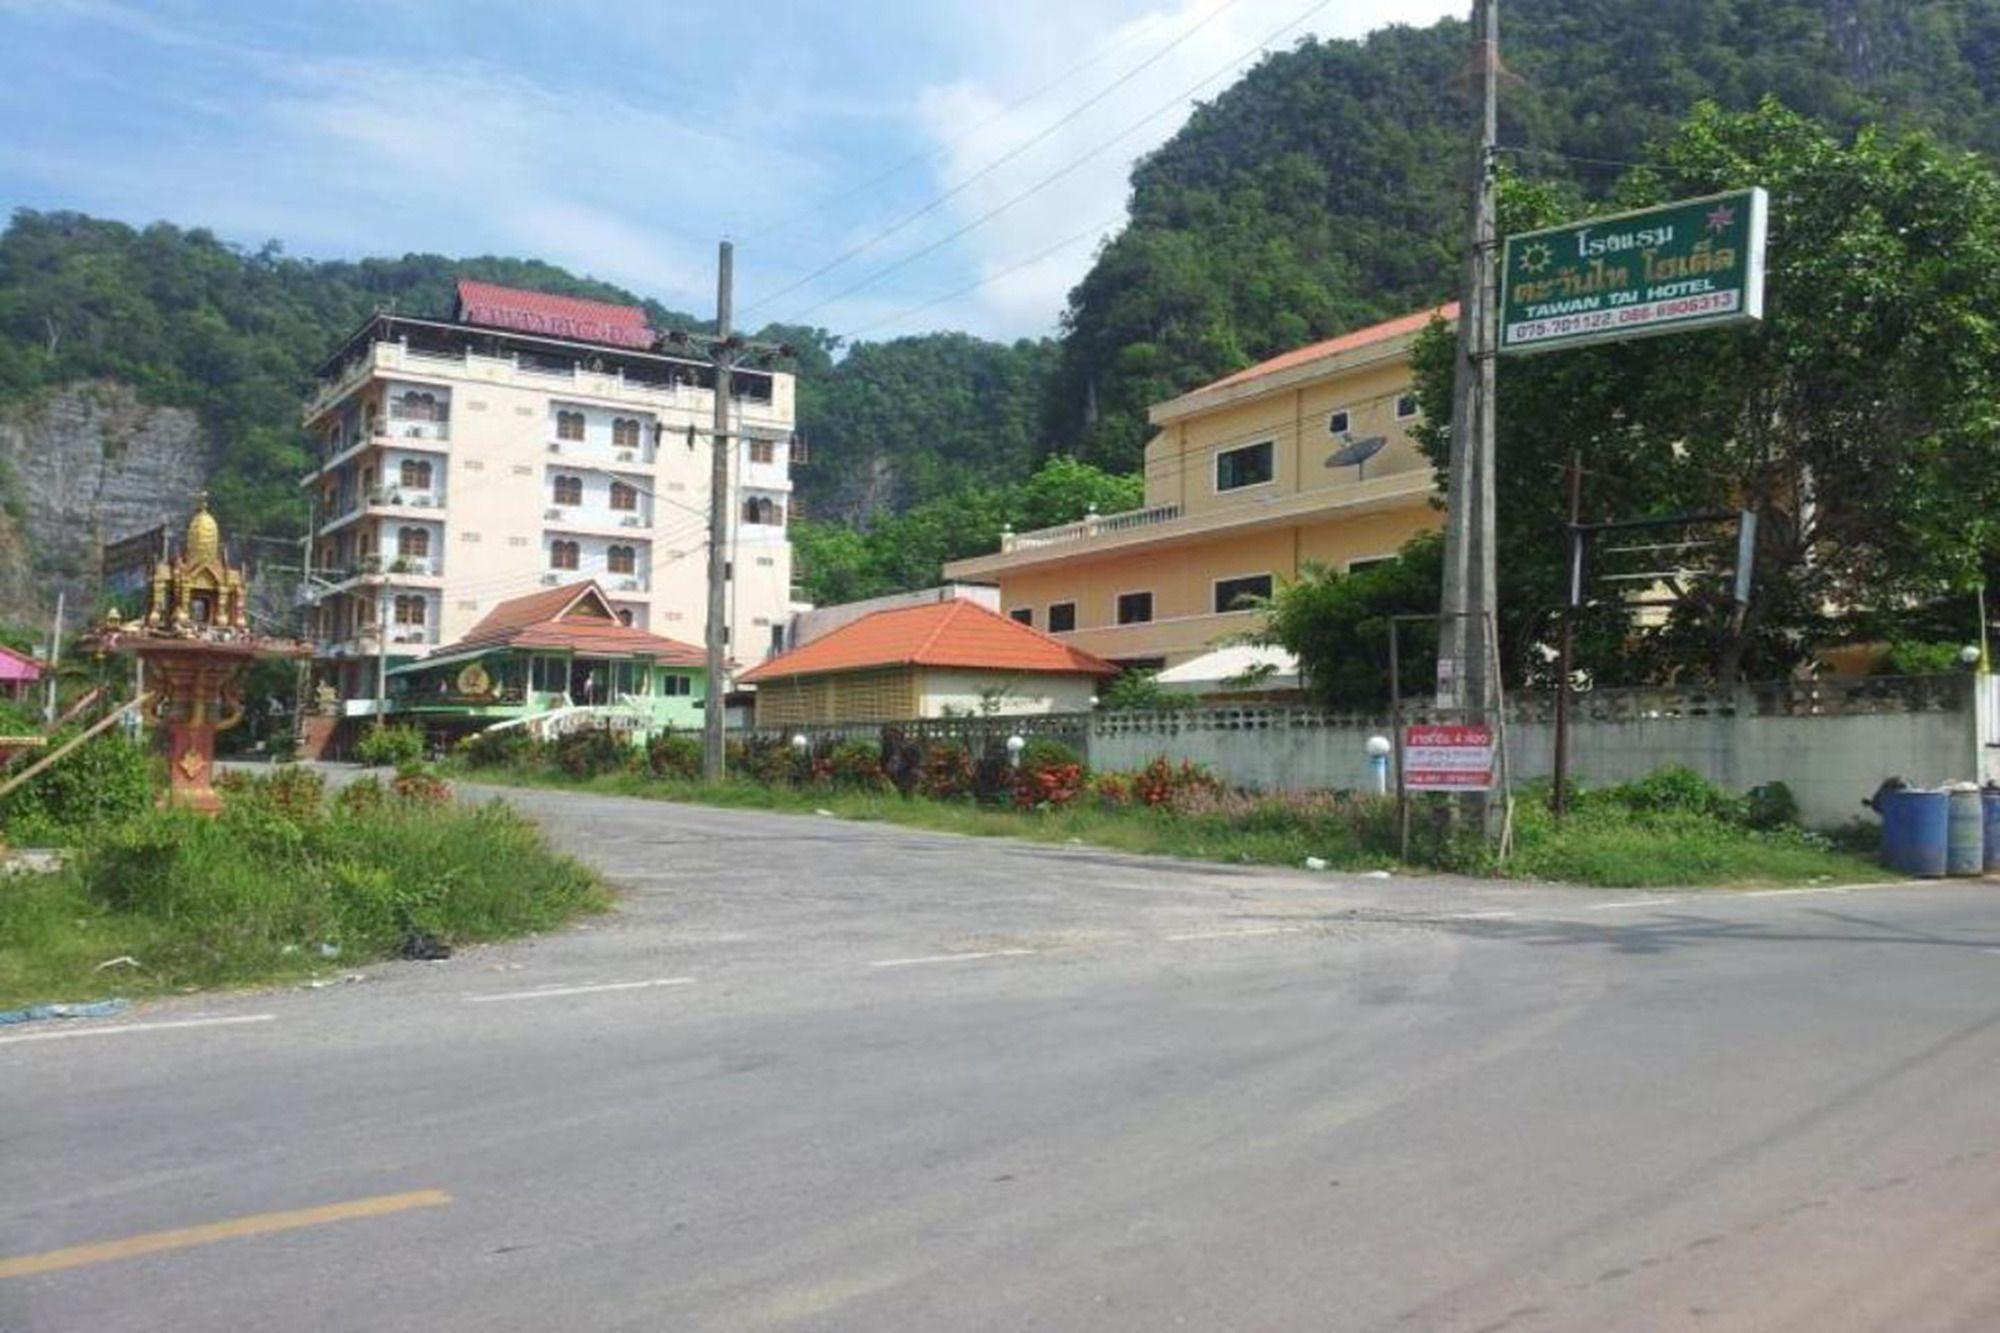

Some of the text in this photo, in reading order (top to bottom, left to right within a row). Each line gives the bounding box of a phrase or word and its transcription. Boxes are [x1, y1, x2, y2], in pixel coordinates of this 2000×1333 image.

[1526, 279, 1716, 319] TAWAN TAI HOTEL
